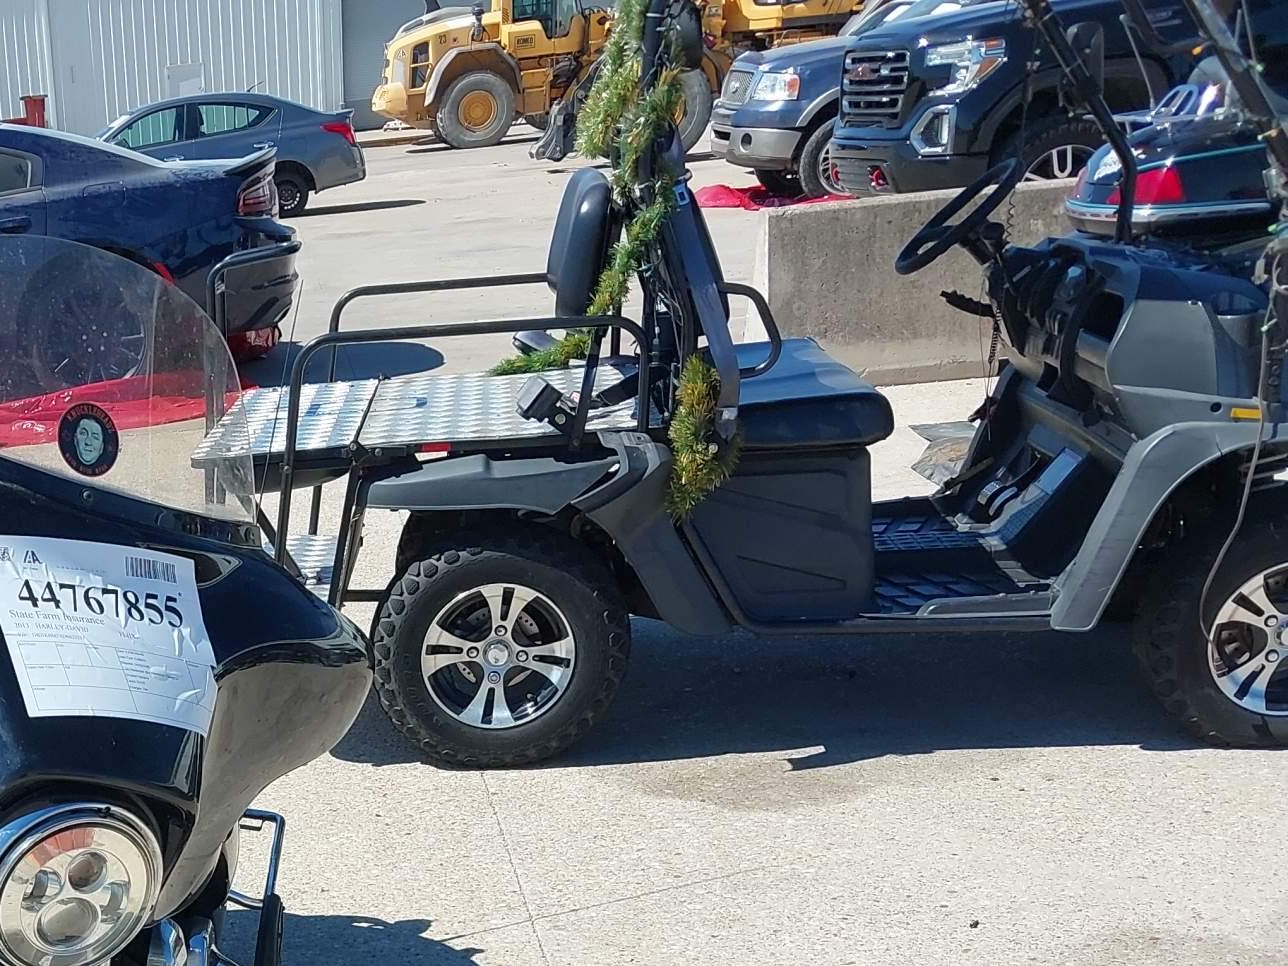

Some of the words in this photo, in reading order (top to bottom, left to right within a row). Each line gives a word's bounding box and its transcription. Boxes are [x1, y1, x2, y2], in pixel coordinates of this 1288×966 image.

[8, 609, 33, 619] State
[36, 611, 61, 621] Farm
[63, 613, 105, 625] Insurance
[18, 579, 183, 628] 44767855
